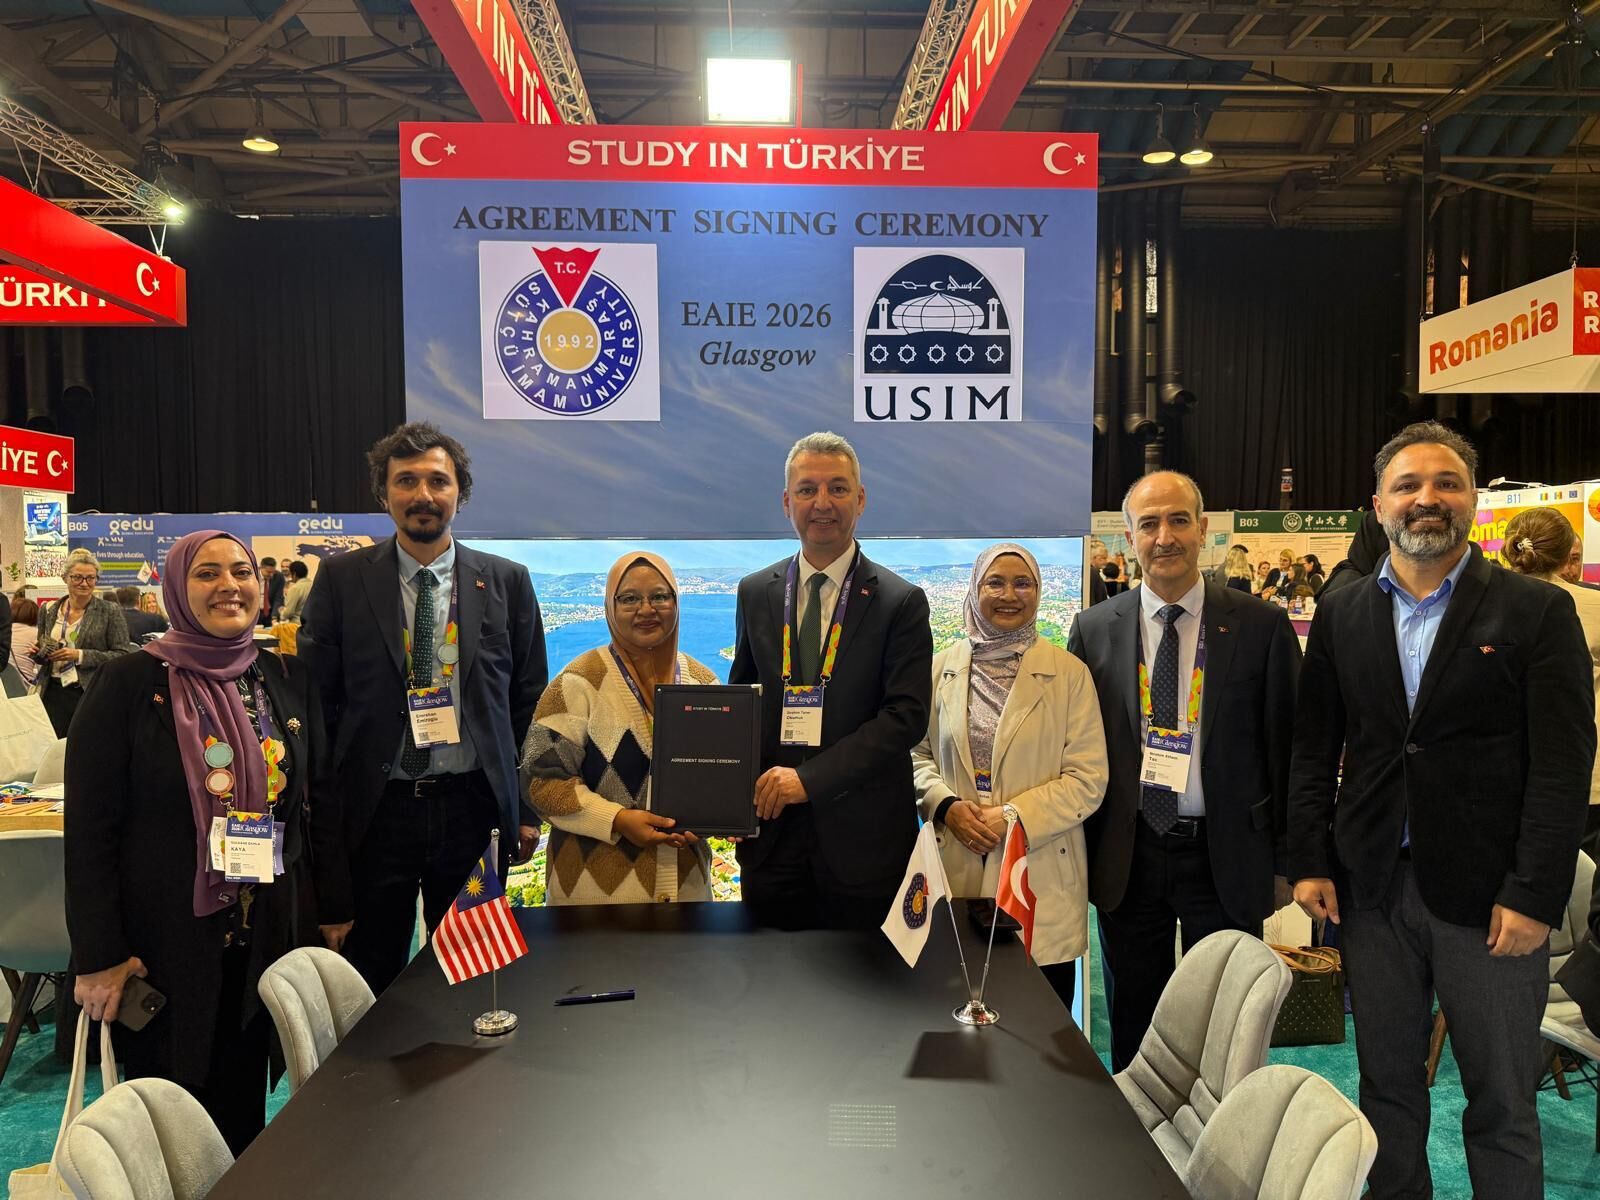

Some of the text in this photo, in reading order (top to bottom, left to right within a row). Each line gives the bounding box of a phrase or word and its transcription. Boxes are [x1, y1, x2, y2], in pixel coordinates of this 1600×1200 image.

[567, 137, 925, 171] STUDY IN TÜRKİYE
[453, 205, 1048, 238] AGREEMENT SIGNING CEREMONY
[554, 262, 581, 274] T.C.
[681, 301, 832, 328] EAIE 2026
[544, 335, 594, 349] 1992
[580, 285, 636, 408] UNIVERSITY
[1429, 298, 1560, 375] Romania
[700, 341, 816, 372] Glasgow
[864, 385, 1011, 421] USIM
[0, 441, 39, 475] İYE
[68, 521, 89, 532] B05
[109, 516, 154, 536] gedu
[298, 516, 343, 534] gedu
[1239, 518, 1259, 528] B03
[1304, 514, 1348, 527] 中山大學
